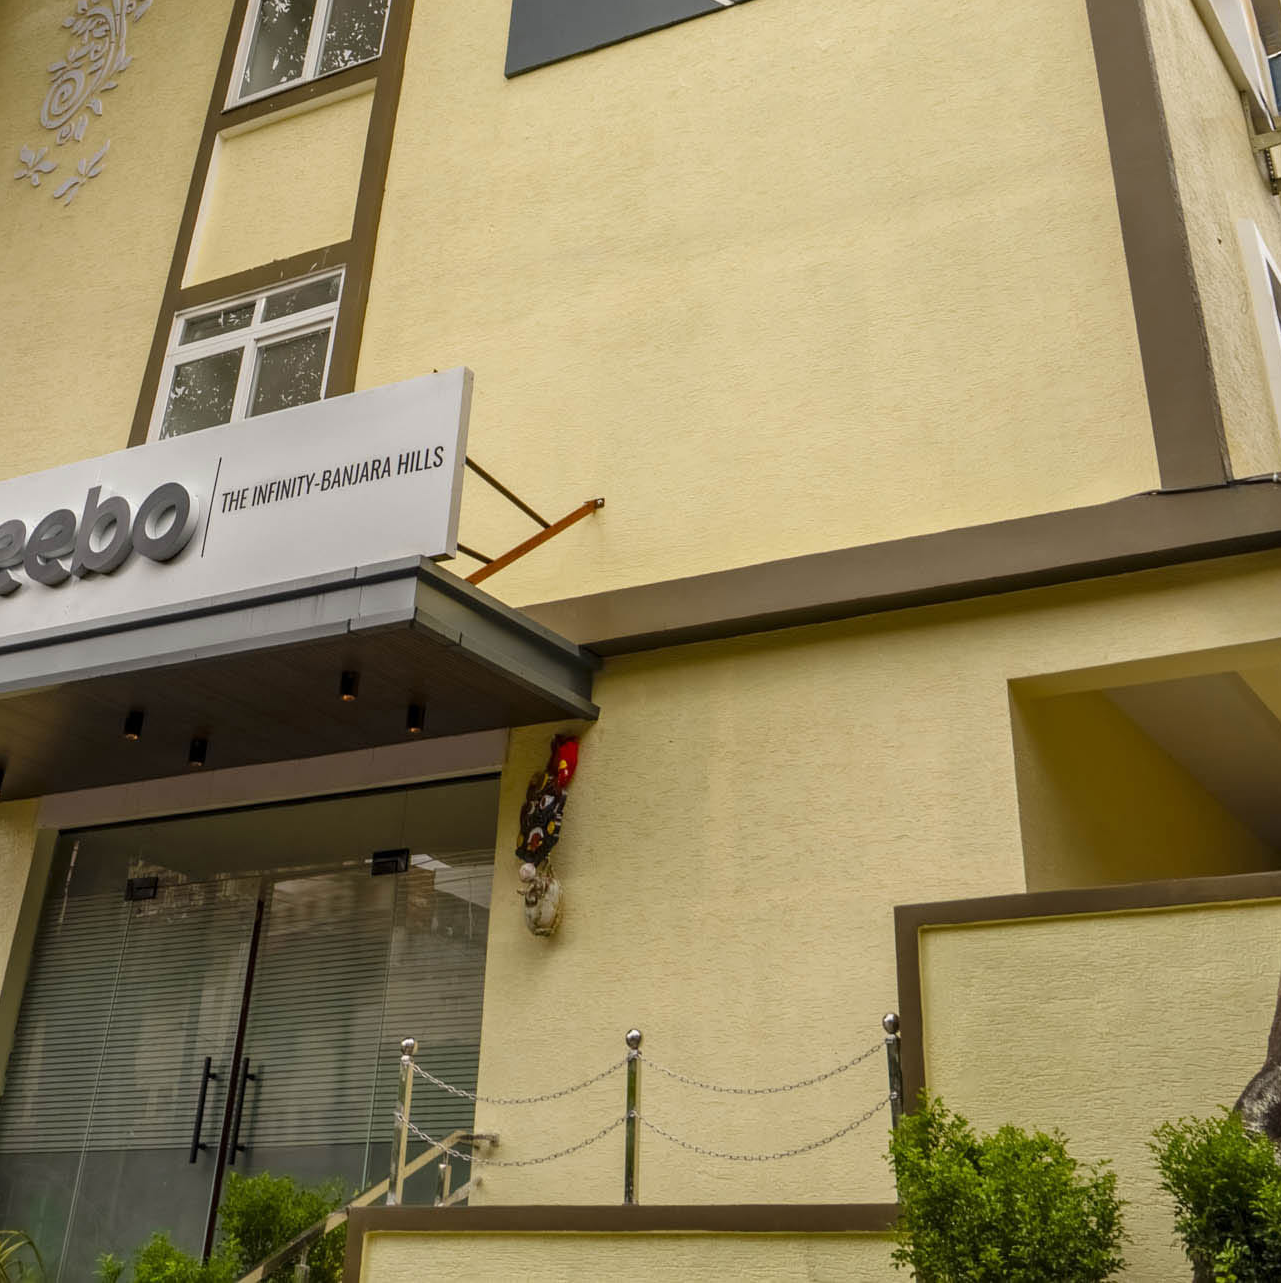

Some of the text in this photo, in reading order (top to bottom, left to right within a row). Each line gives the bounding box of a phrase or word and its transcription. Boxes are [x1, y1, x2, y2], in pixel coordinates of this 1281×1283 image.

[221, 445, 445, 514] THE INFINITY-BANJARA HILLS
